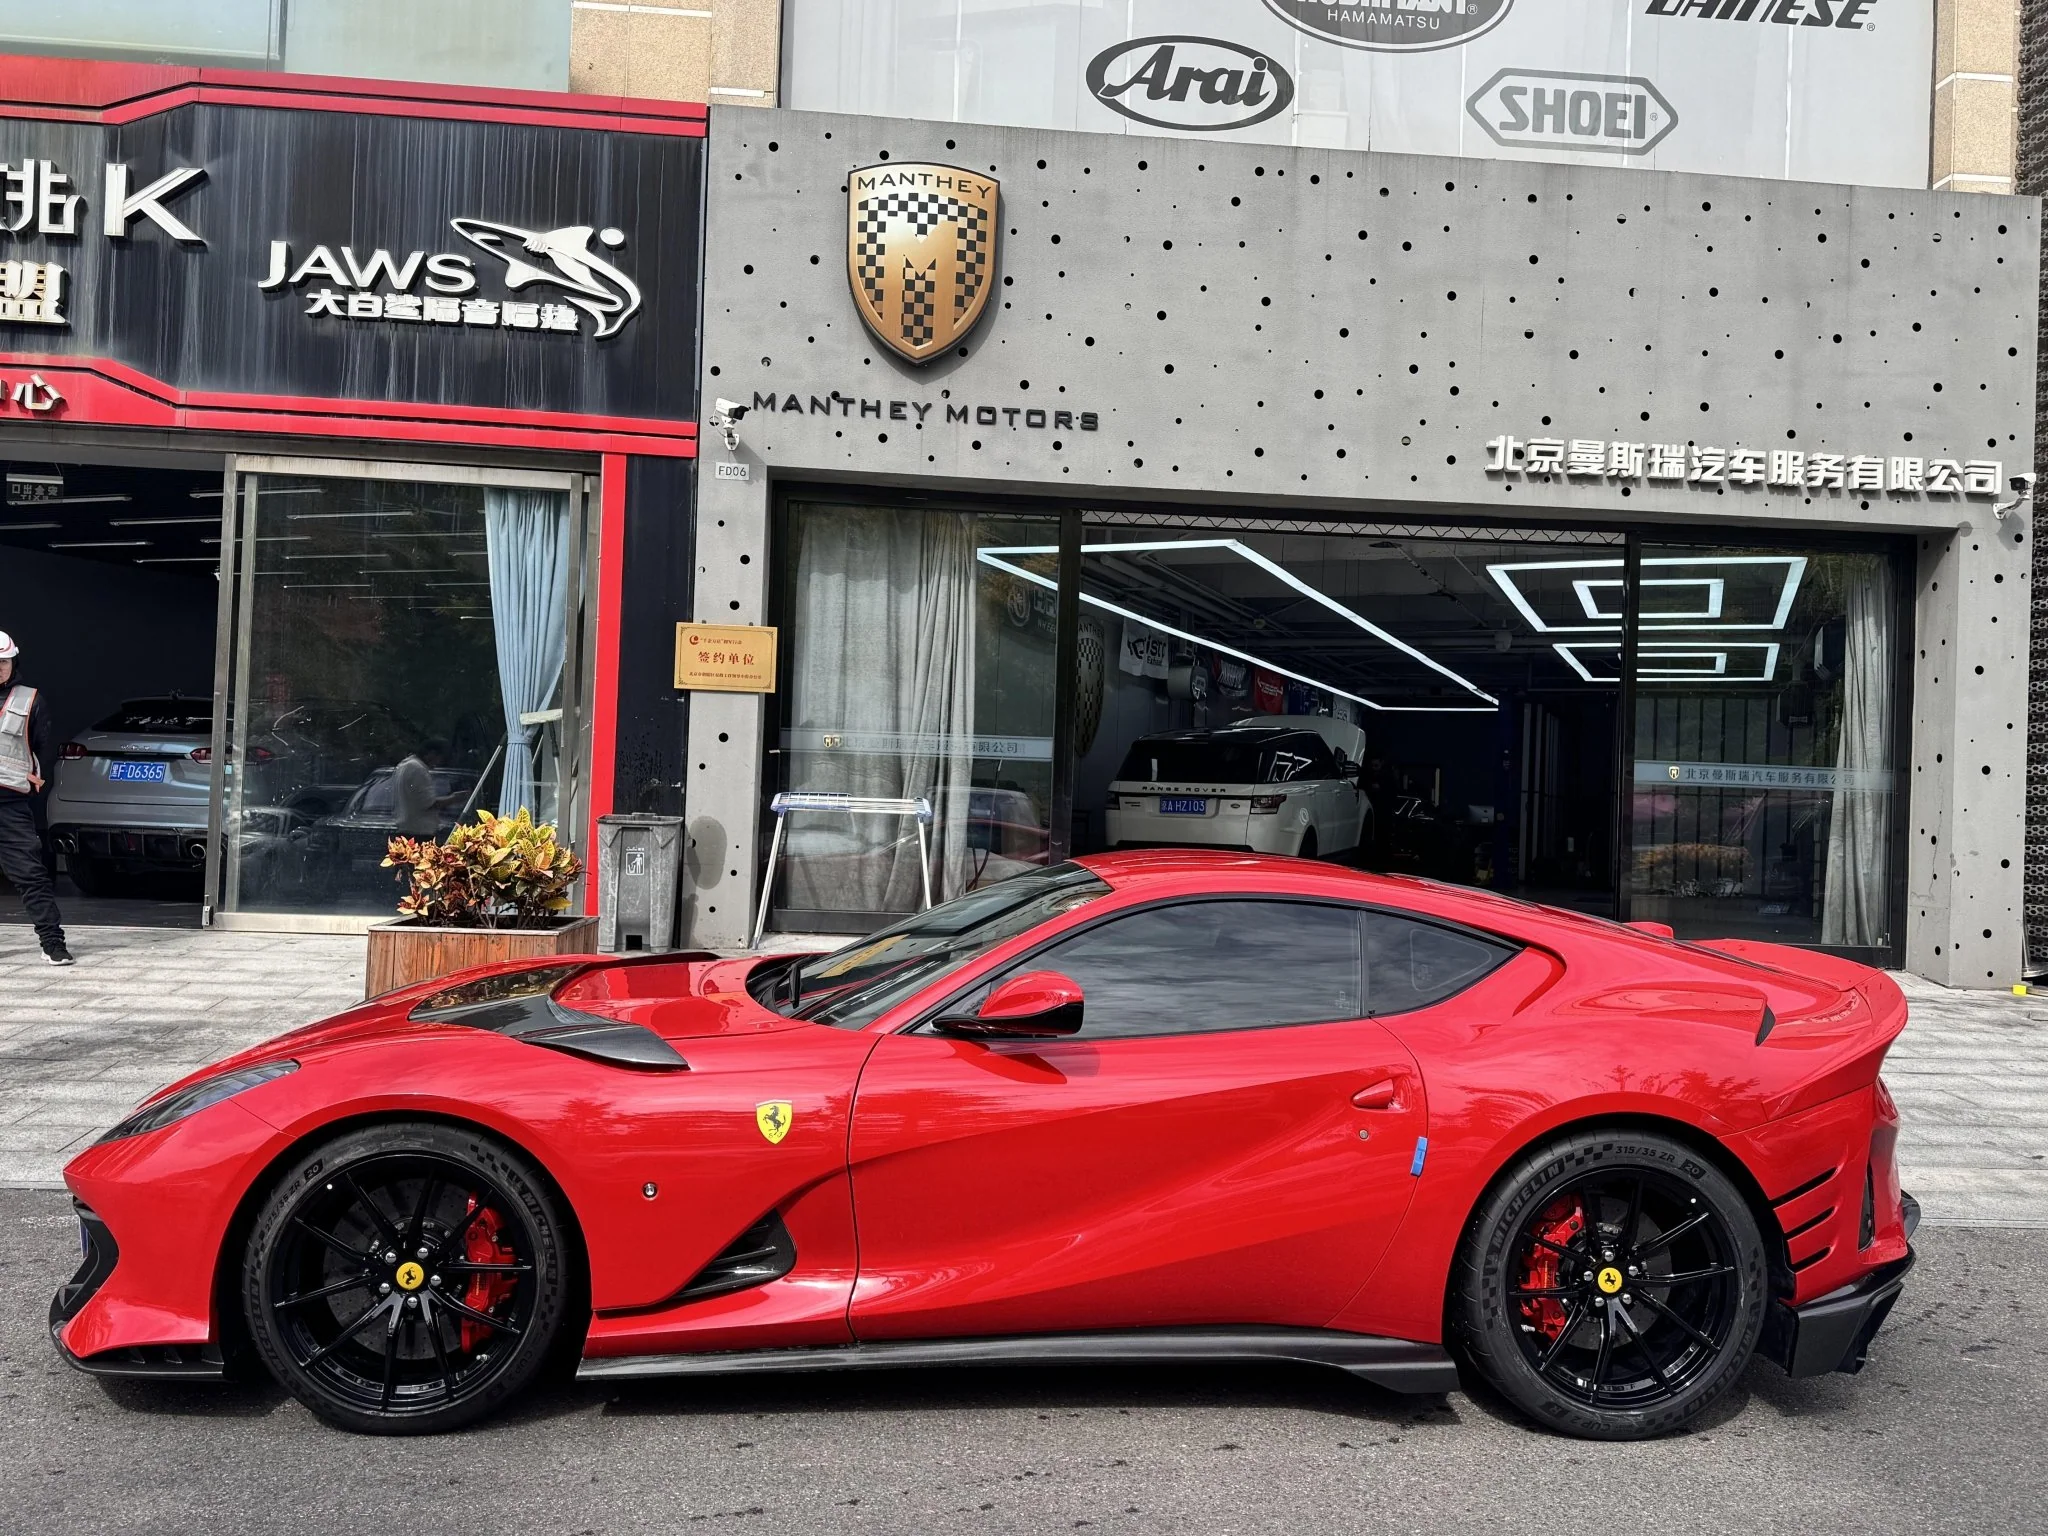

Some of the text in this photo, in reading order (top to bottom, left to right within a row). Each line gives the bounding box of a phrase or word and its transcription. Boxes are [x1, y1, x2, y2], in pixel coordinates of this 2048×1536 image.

[1327, 9, 1440, 29] HAMAMATSU
[1100, 44, 1270, 107] Arai
[1499, 85, 1647, 139] SHOEI
[858, 172, 991, 199] MANTHEY
[257, 240, 477, 294] JAWS
[0, 373, 63, 411] 心
[753, 390, 1099, 431] MANTHEY MOTORS
[718, 465, 748, 477] FD06
[1484, 434, 2004, 497] 北京曼斯瑞汽车服务有限公司
[698, 651, 755, 666] 签约单位
[288, 1180, 301, 1195] ZR
[306, 1164, 320, 1178] 20
[1615, 1145, 1700, 1175] 315/35 ZR 20
[1492, 1162, 1561, 1249] MICHELIN
[521, 1190, 557, 1282] MICHELIN
